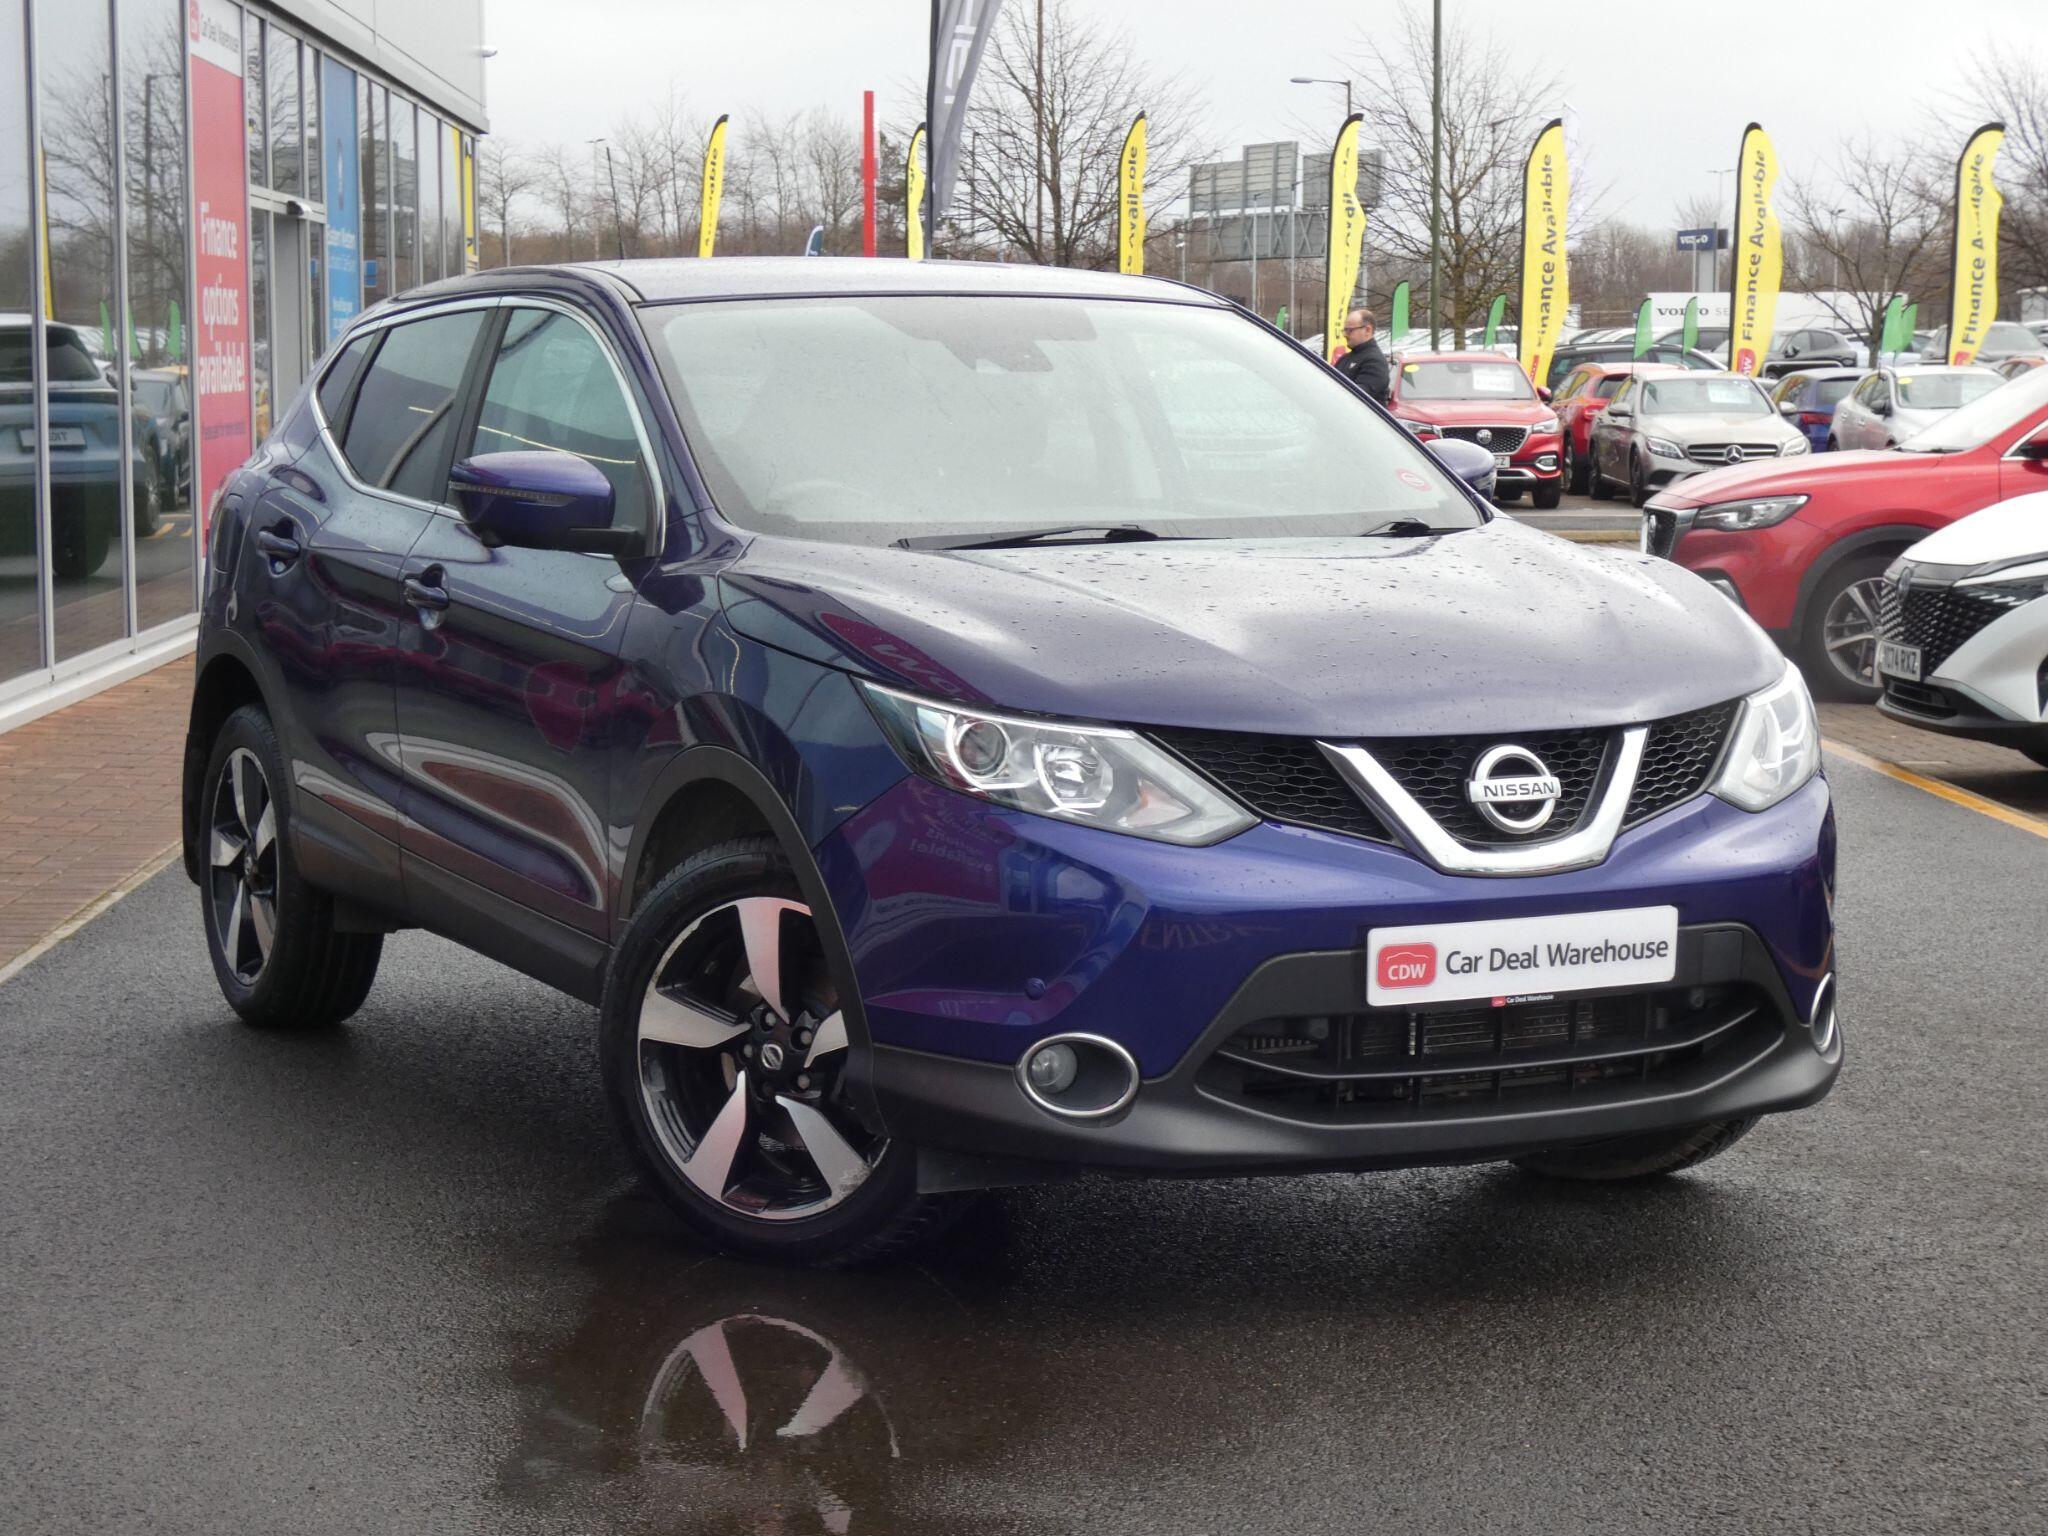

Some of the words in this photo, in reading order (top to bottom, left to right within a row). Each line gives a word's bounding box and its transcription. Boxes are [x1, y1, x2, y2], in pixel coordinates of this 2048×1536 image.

[199, 201, 238, 260] Finance
[1541, 154, 1557, 255] Available
[1970, 153, 1984, 249] Alable
[202, 273, 240, 341] options
[1657, 307, 1709, 316] VOLO
[1742, 252, 1760, 341] Finance
[1962, 257, 1985, 345] Finance
[199, 341, 246, 396] available!
[1484, 781, 1555, 798] NISSAN
[1388, 963, 1427, 981] CDW
[1446, 950, 1482, 975] Car
[1489, 946, 1539, 972] Deal
[1547, 938, 1669, 967] Warehouse
